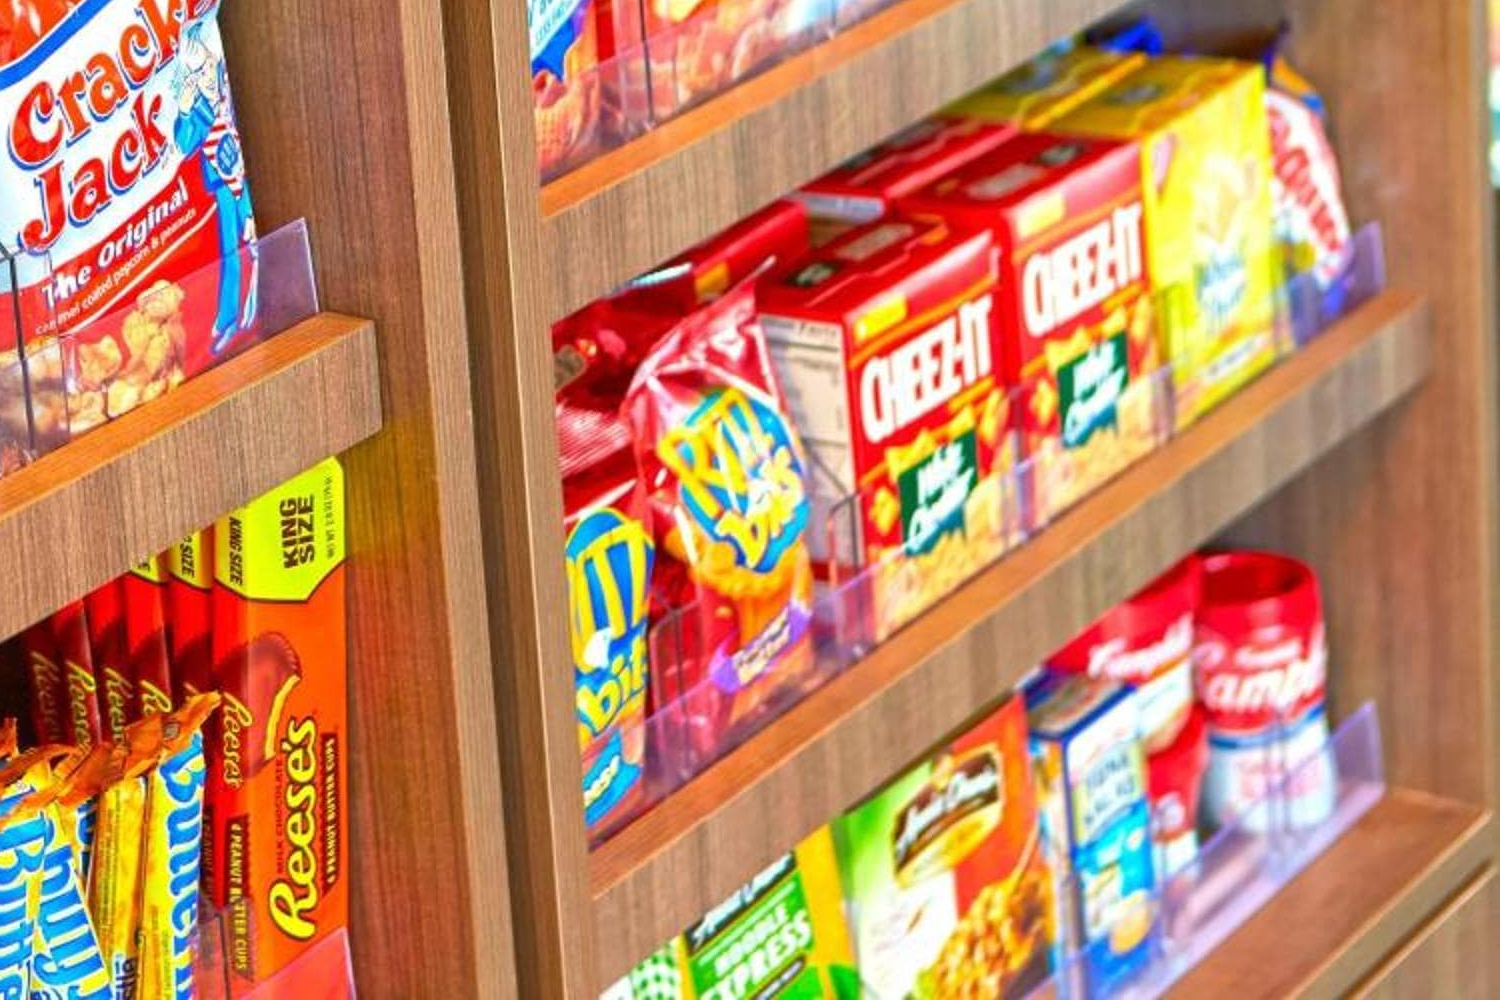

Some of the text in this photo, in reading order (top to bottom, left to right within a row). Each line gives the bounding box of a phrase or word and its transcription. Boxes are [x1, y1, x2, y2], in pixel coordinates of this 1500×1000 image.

[15, 90, 169, 256] Jack
[41, 175, 191, 312] The Original
[113, 246, 153, 287] popcorn
[860, 295, 994, 446] CHEEZ-IT
[228, 517, 243, 586] KING SIZE
[279, 495, 299, 571] KING
[298, 493, 316, 565] SIZE
[222, 692, 254, 790] Reese's
[324, 736, 336, 775] CUPS
[268, 717, 318, 941] Reese's
[324, 777, 336, 823] BUTTER
[232, 834, 245, 884] PEANUT
[324, 824, 336, 876] PEANUT
[235, 938, 249, 972] CUPS
